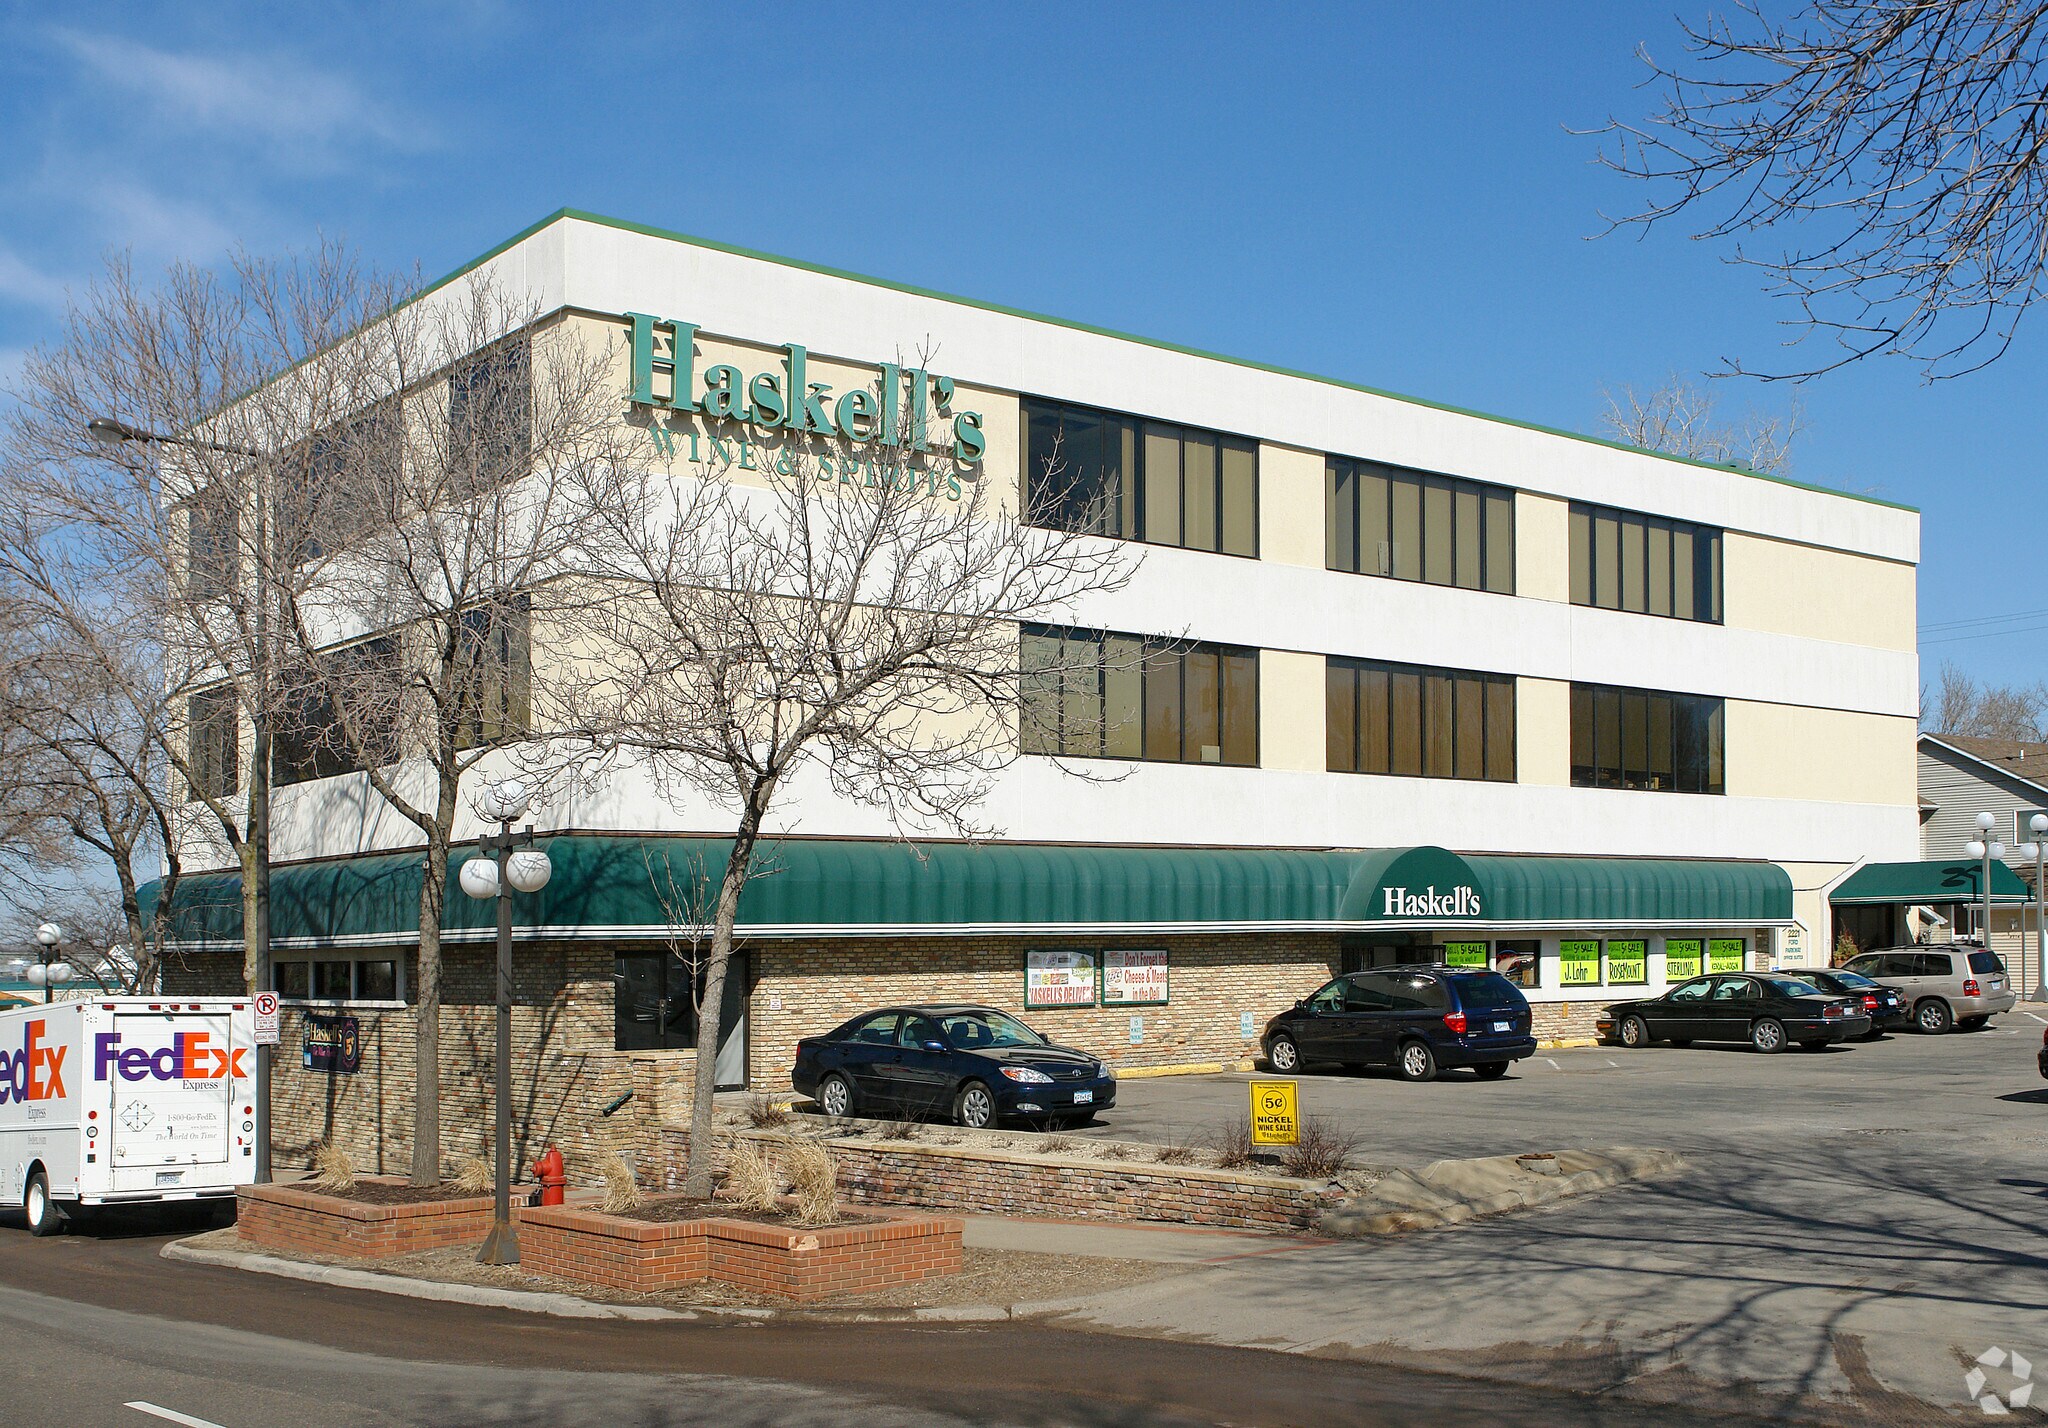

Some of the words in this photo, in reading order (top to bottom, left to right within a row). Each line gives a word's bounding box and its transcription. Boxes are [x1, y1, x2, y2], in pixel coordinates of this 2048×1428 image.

[623, 311, 986, 463] Haskell's
[649, 426, 758, 471] WINE
[817, 452, 962, 502] SPIRITS
[1383, 886, 1480, 916] Haskell's
[1788, 929, 1800, 937] 2221
[1468, 944, 1485, 954] SALE!
[1581, 943, 1597, 953] SALE!
[1628, 942, 1644, 952] SALE!
[1125, 952, 1138, 966] Don't
[1140, 952, 1157, 969] Forget
[1159, 952, 1167, 966] the
[1609, 962, 1641, 980] ROSEMOUNT
[1667, 961, 1695, 976] STERLING
[1125, 970, 1144, 983] Cheese
[1146, 970, 1150, 983] &
[1152, 970, 1167, 983] Meats
[1132, 987, 1138, 1000] in
[1139, 987, 1148, 1000] the
[310, 1023, 342, 1043] Haskell's
[94, 1032, 248, 1081] FedEx
[182, 1080, 218, 1091] Express
[1266, 1097, 1282, 1109] 5¢
